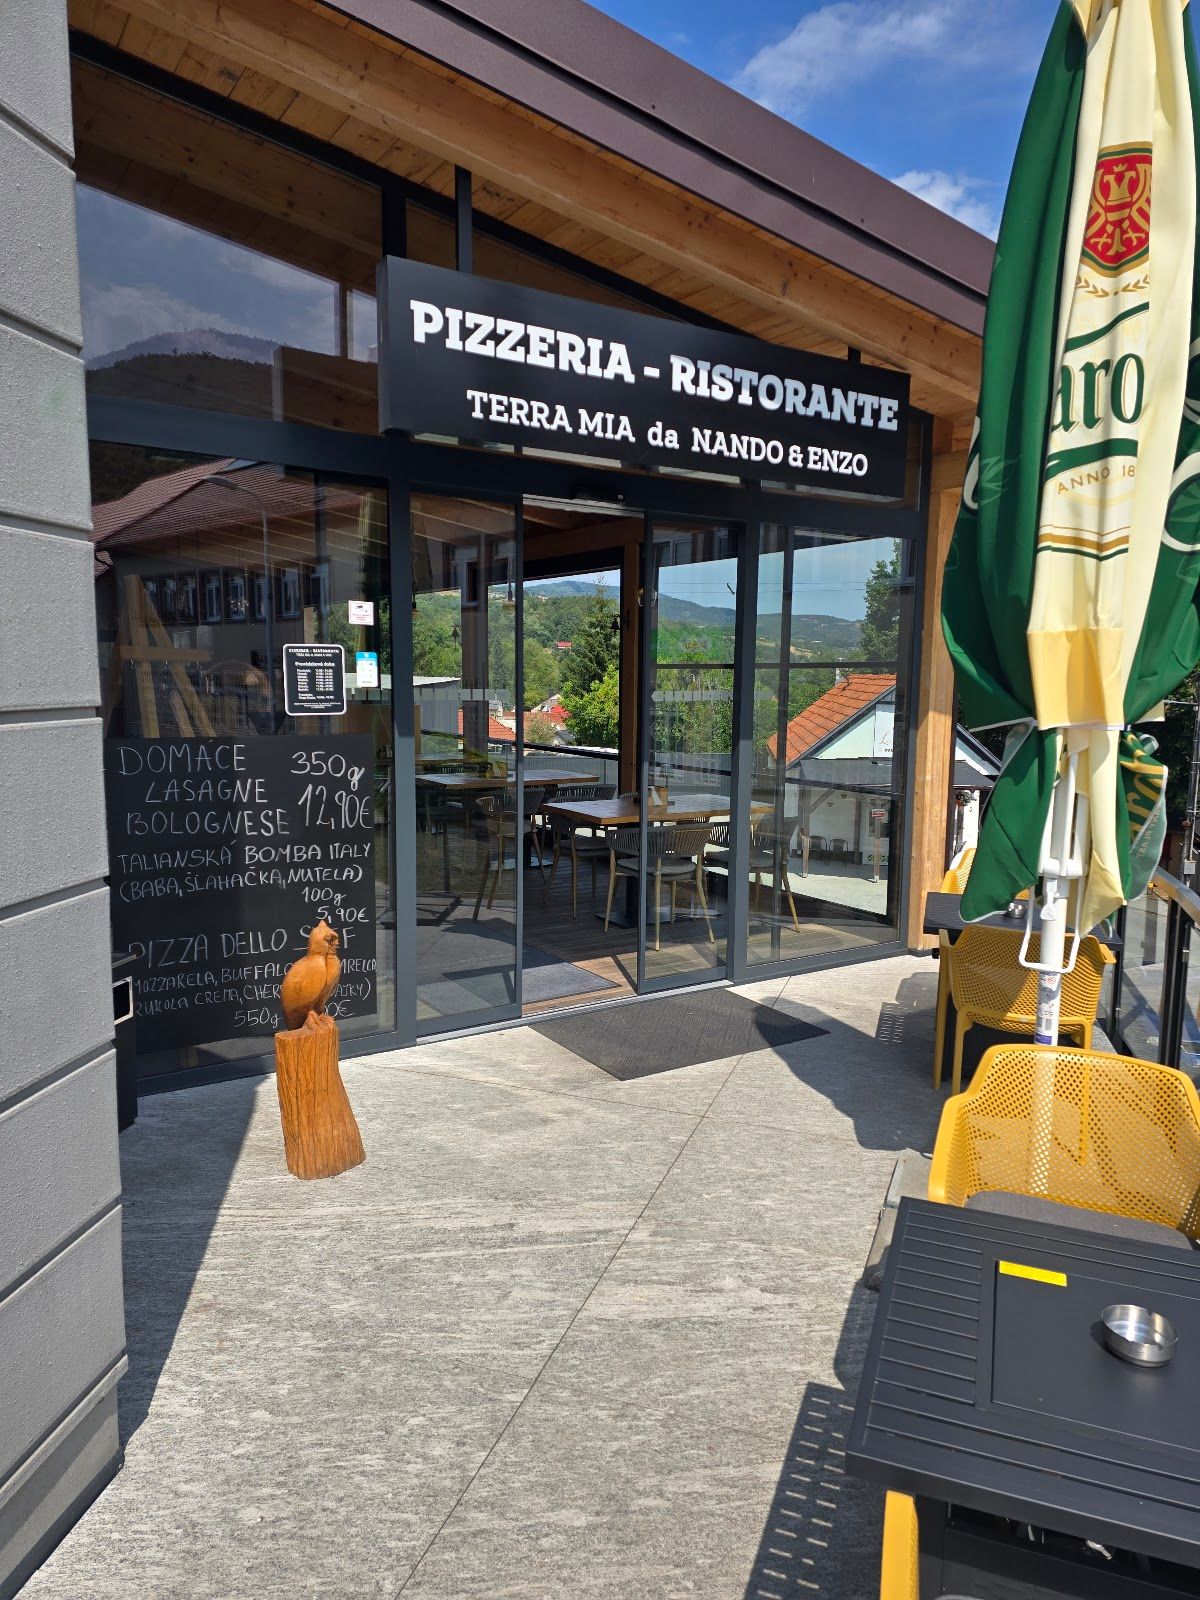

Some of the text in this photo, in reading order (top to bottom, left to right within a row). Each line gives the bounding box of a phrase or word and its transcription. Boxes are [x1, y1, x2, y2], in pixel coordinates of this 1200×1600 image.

[409, 299, 636, 384] PIZZERIA
[669, 354, 899, 431] RISTORANTE
[466, 388, 869, 477] TERRA MIA da NANDO & ENZO
[1058, 467, 1110, 495] ANNO
[290, 751, 366, 791] 350g
[145, 778, 269, 803] LASAGNE
[297, 783, 373, 830] 12,90€
[127, 808, 290, 837] BOLOGNESE
[244, 844, 322, 864] BOMBA
[328, 842, 371, 860] ITALY
[301, 886, 347, 907] 100g
[315, 905, 370, 924] 5,90€
[220, 928, 288, 958] DELLO
[233, 1007, 280, 1029] 550g
